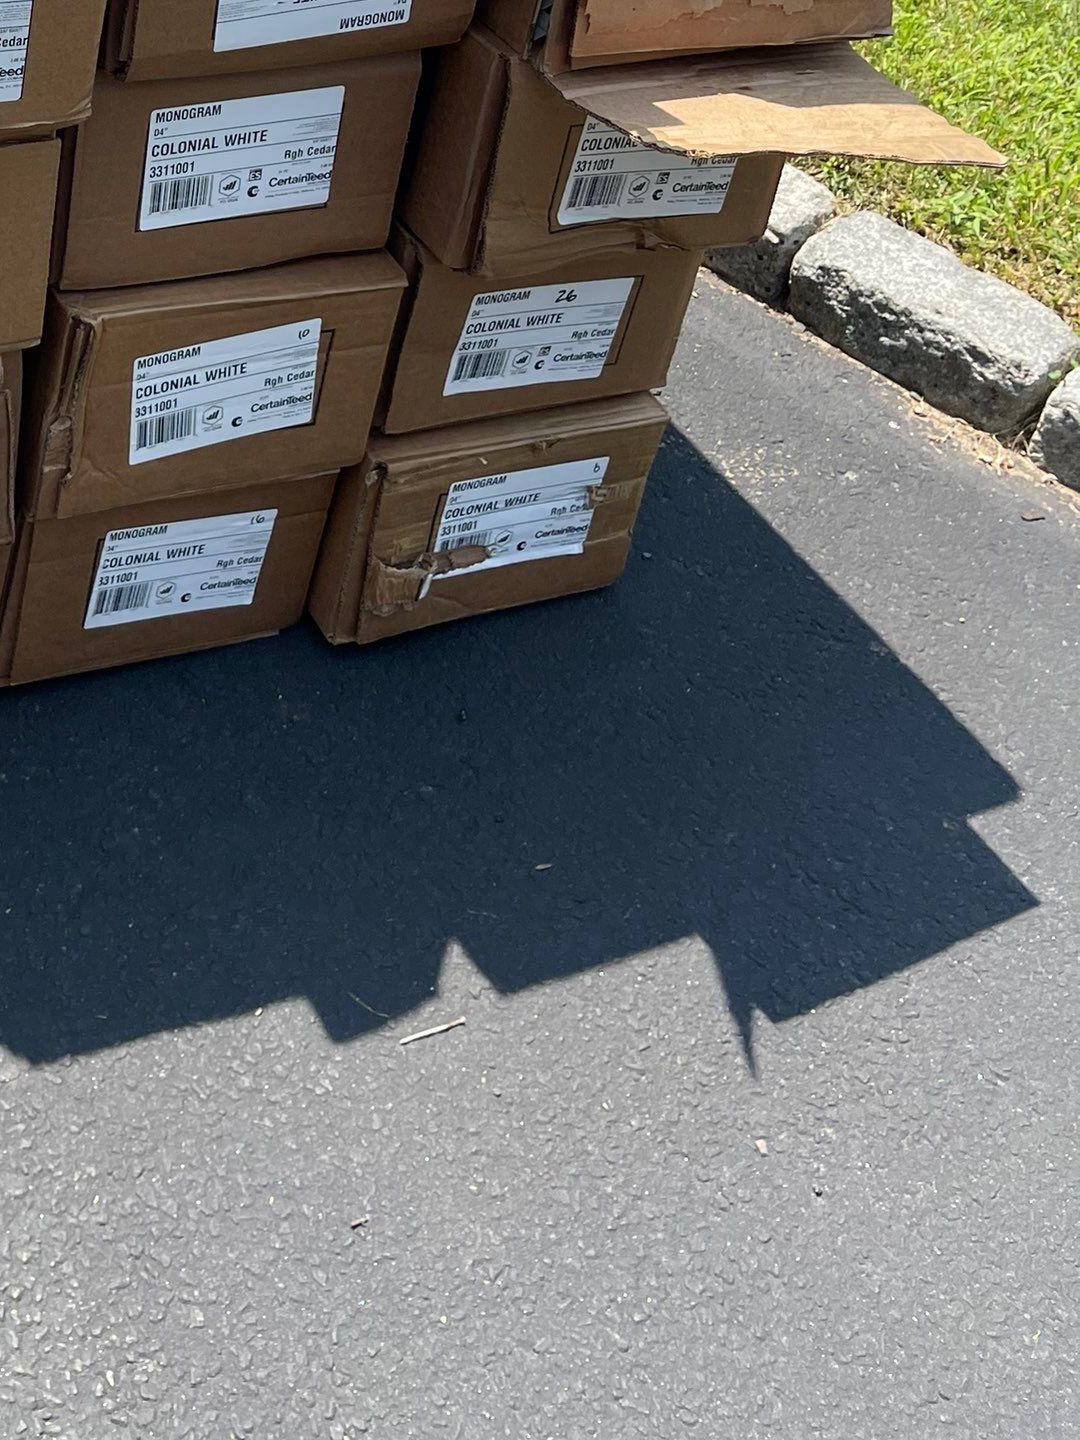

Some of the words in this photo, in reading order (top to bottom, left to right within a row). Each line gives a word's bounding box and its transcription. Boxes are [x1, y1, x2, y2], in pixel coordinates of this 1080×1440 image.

[340, 10, 404, 29] MONOGRAM
[156, 105, 222, 123] MONOGRAM
[154, 127, 167, 136] D4"
[152, 137, 218, 157] COLONIAL
[225, 130, 268, 146] WHITE
[285, 149, 304, 160] Rgh
[307, 145, 336, 156] Cedar
[150, 161, 195, 178] 3311001
[575, 159, 614, 172] 3311001
[269, 171, 332, 187] CertainTeed
[673, 181, 728, 192] CertainTeed
[476, 291, 531, 306] MONOGRAM
[555, 290, 577, 303] 26
[466, 318, 520, 335] COLONIAL
[526, 313, 564, 327] WHITE
[571, 330, 588, 339] Rgh
[591, 328, 615, 337] Cedar
[459, 339, 498, 351] 3311001
[138, 346, 201, 369] MONOGRAM
[553, 351, 607, 362] CertainTeed
[136, 374, 200, 399] COLONIAL
[206, 362, 247, 382] WHITE
[264, 376, 283, 387] Rgh
[287, 370, 314, 382] Cedar
[135, 398, 178, 418] 3311001
[251, 393, 312, 412] CertainTeed
[452, 476, 507, 493] MONOGRAM
[445, 501, 499, 520] COLONIAL
[505, 493, 541, 507] WHITE
[109, 525, 168, 541] MONOGRAM
[441, 521, 477, 536] 3311001
[535, 525, 588, 539] CertainTeed
[103, 551, 161, 569] COLONIAL
[167, 544, 206, 558] WHITE
[217, 559, 234, 569] Rgh
[237, 556, 262, 565] Cedar
[99, 572, 138, 586] 3311001
[200, 577, 256, 591] CertainTeed
